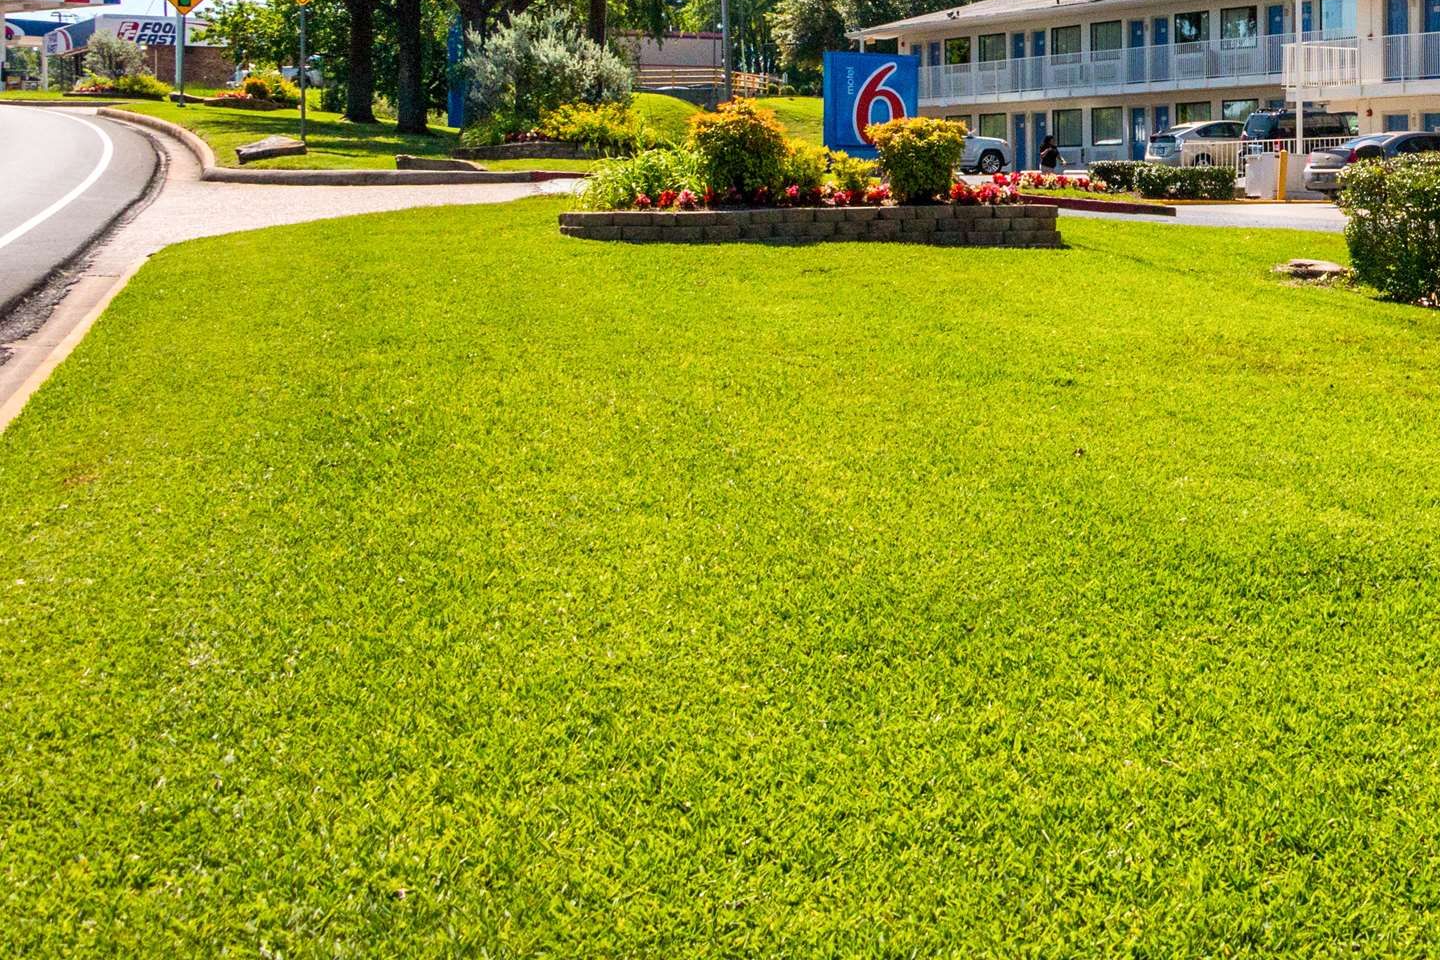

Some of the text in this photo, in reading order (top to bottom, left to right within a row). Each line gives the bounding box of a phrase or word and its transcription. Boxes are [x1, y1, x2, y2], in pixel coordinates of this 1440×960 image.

[141, 22, 176, 33] FOO
[846, 62, 907, 145] motel 6
